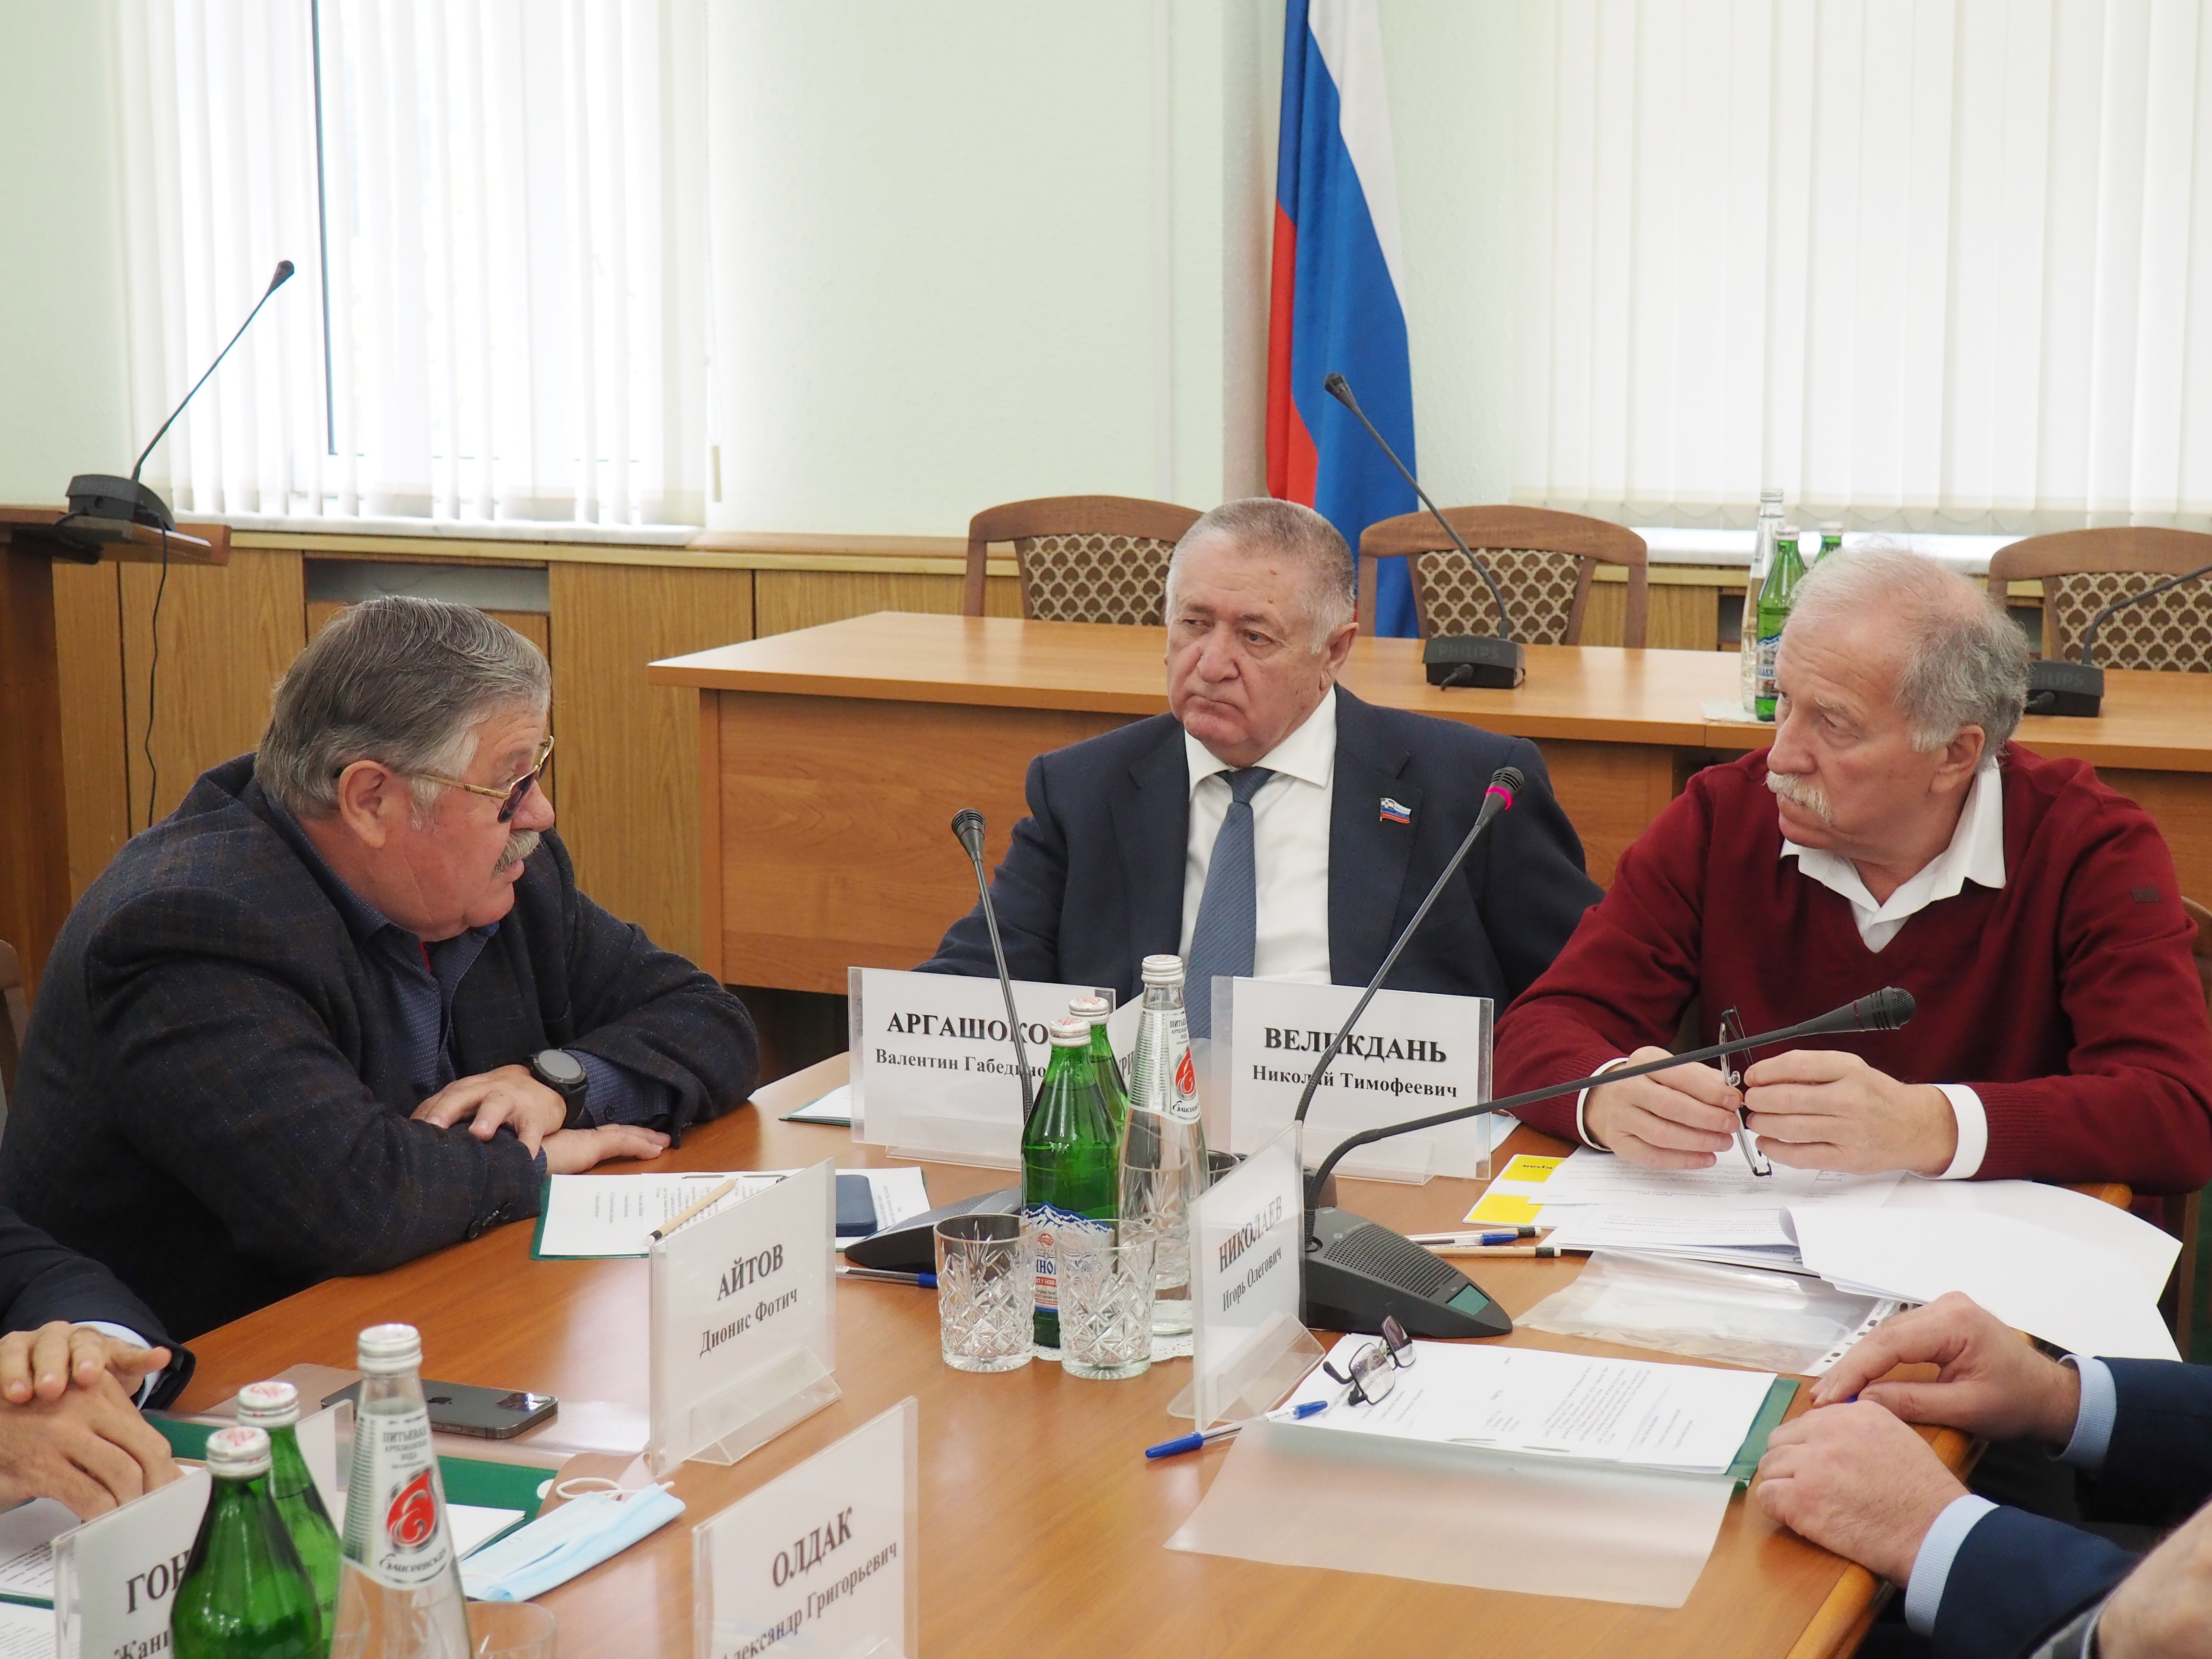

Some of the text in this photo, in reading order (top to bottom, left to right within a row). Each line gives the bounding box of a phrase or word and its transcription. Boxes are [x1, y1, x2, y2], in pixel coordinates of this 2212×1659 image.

[876, 1048, 958, 1070] Валентин
[1252, 1064, 1457, 1098] Николй Тимофеевич
[1219, 1195, 1282, 1273] НИКОЛАЕВ
[717, 1244, 783, 1300] АЙТОВ
[1223, 1247, 1281, 1312] Игорь Олегович
[699, 1288, 797, 1360] Дионис Фотич
[773, 1506, 853, 1587] ОЛДАК
[722, 1542, 897, 1659] лександр Григорьевич
